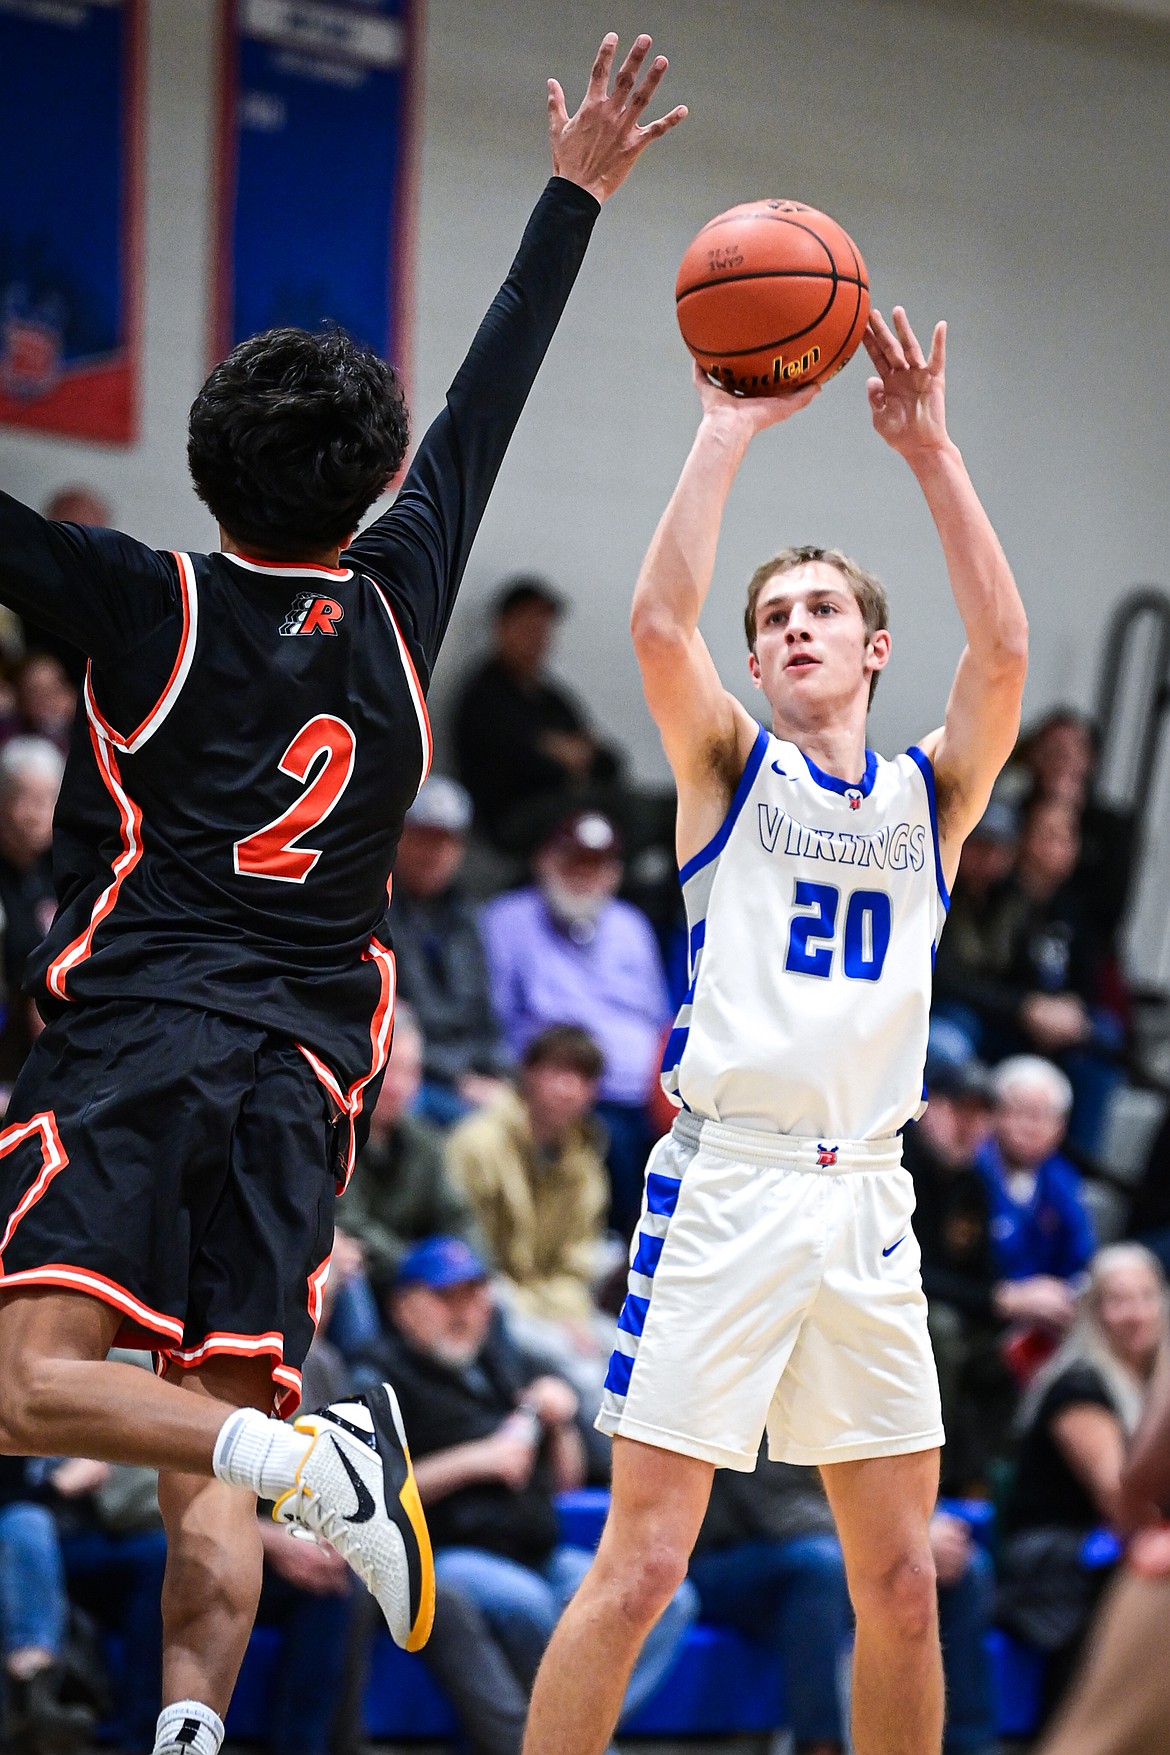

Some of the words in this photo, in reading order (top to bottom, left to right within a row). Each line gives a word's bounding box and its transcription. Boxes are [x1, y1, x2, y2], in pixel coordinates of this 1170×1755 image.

[297, 594, 345, 636] R
[233, 713, 357, 884] 2
[758, 803, 926, 872] VIKINGS
[782, 876, 895, 984] 20
